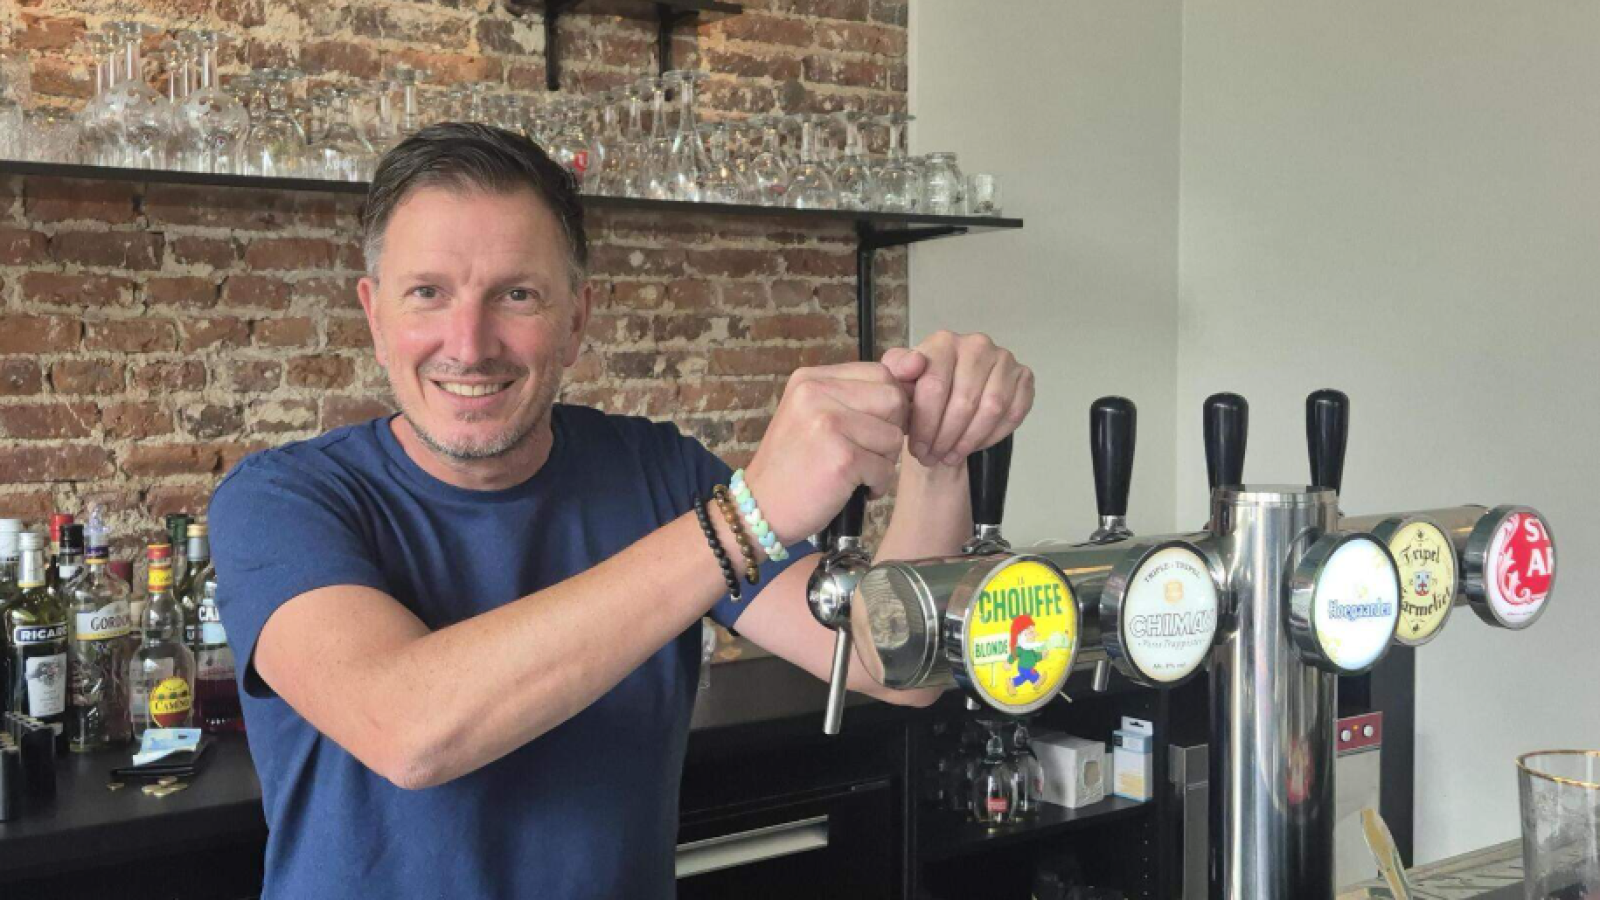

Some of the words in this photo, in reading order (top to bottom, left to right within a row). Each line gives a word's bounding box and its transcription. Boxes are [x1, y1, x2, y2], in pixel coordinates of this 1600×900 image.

[1400, 544, 1440, 567] Tripel
[978, 583, 1063, 625] CHOUFFE
[1401, 586, 1450, 615] armeliet
[975, 639, 1008, 658] BLONDE
